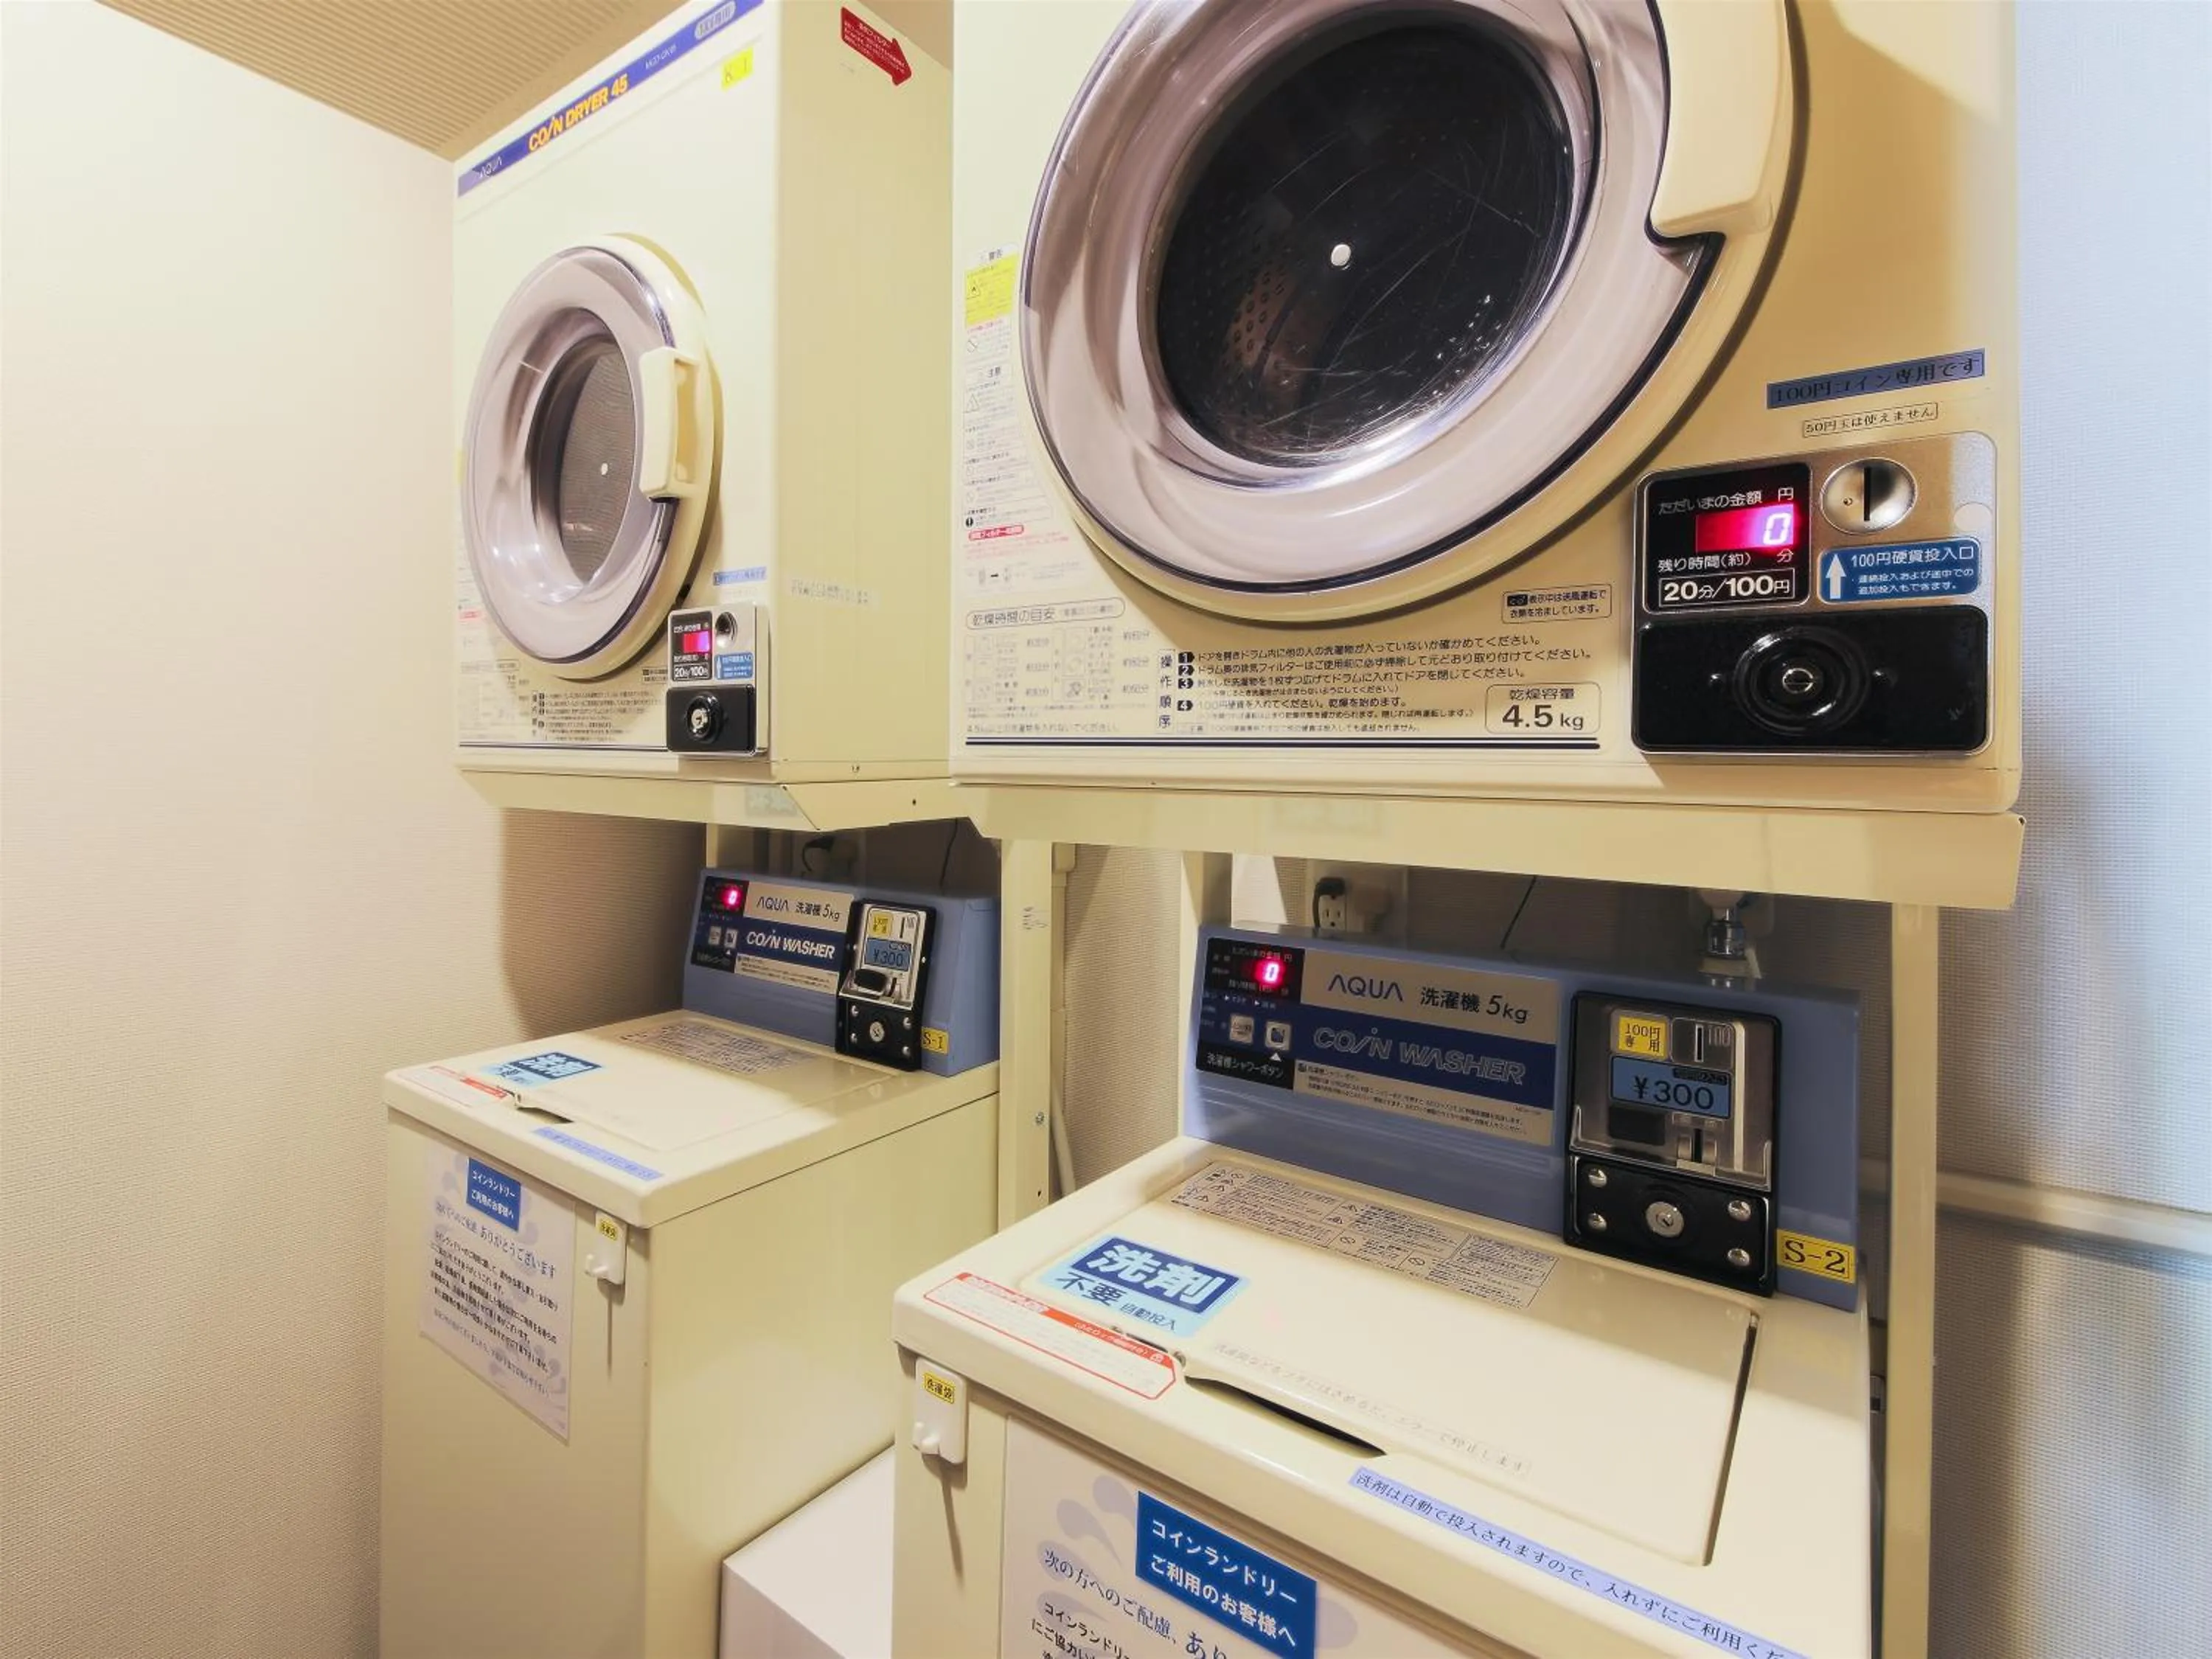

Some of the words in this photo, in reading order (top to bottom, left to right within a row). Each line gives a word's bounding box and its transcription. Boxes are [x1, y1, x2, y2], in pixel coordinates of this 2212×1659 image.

[566, 86, 608, 127] DRYER
[611, 73, 628, 97] 45
[479, 156, 502, 178] AQUA
[1776, 358, 1980, 402] 100円コイン専用です
[1658, 490, 1762, 515] ただいまの金額
[1778, 487, 1794, 502] 円
[1763, 512, 1791, 545] 0
[1776, 548, 1794, 563] 分
[1851, 546, 1975, 568] 100円硬貨投入口
[1663, 574, 1790, 602] 20分/100円
[1509, 687, 1574, 700] 乾燥容量
[728, 889, 738, 905] 0
[757, 896, 789, 911] AQUA
[796, 901, 821, 917] 洗濯機
[783, 936, 836, 960] WASHER
[872, 947, 904, 967] ¥300
[1265, 962, 1280, 983] 0
[1328, 974, 1403, 1002] AQUA
[1419, 986, 1481, 1013] 洗濯機
[1486, 995, 1528, 1025] 5kg
[923, 1033, 943, 1049] S-1
[1624, 1023, 1661, 1041] 100円
[1399, 1043, 1526, 1087] WASHER
[1632, 1074, 1715, 1110] ¥300
[1784, 1239, 1847, 1275] S-2
[1086, 1243, 1220, 1306] 洗剤
[1051, 1272, 1130, 1307] 不要
[1119, 1301, 1178, 1332] 自動投入
[1152, 1518, 1298, 1604] コインランドリー
[1150, 1554, 1297, 1647] ご利用のお客様へ
[1044, 1601, 1130, 1659] コインランドリ
